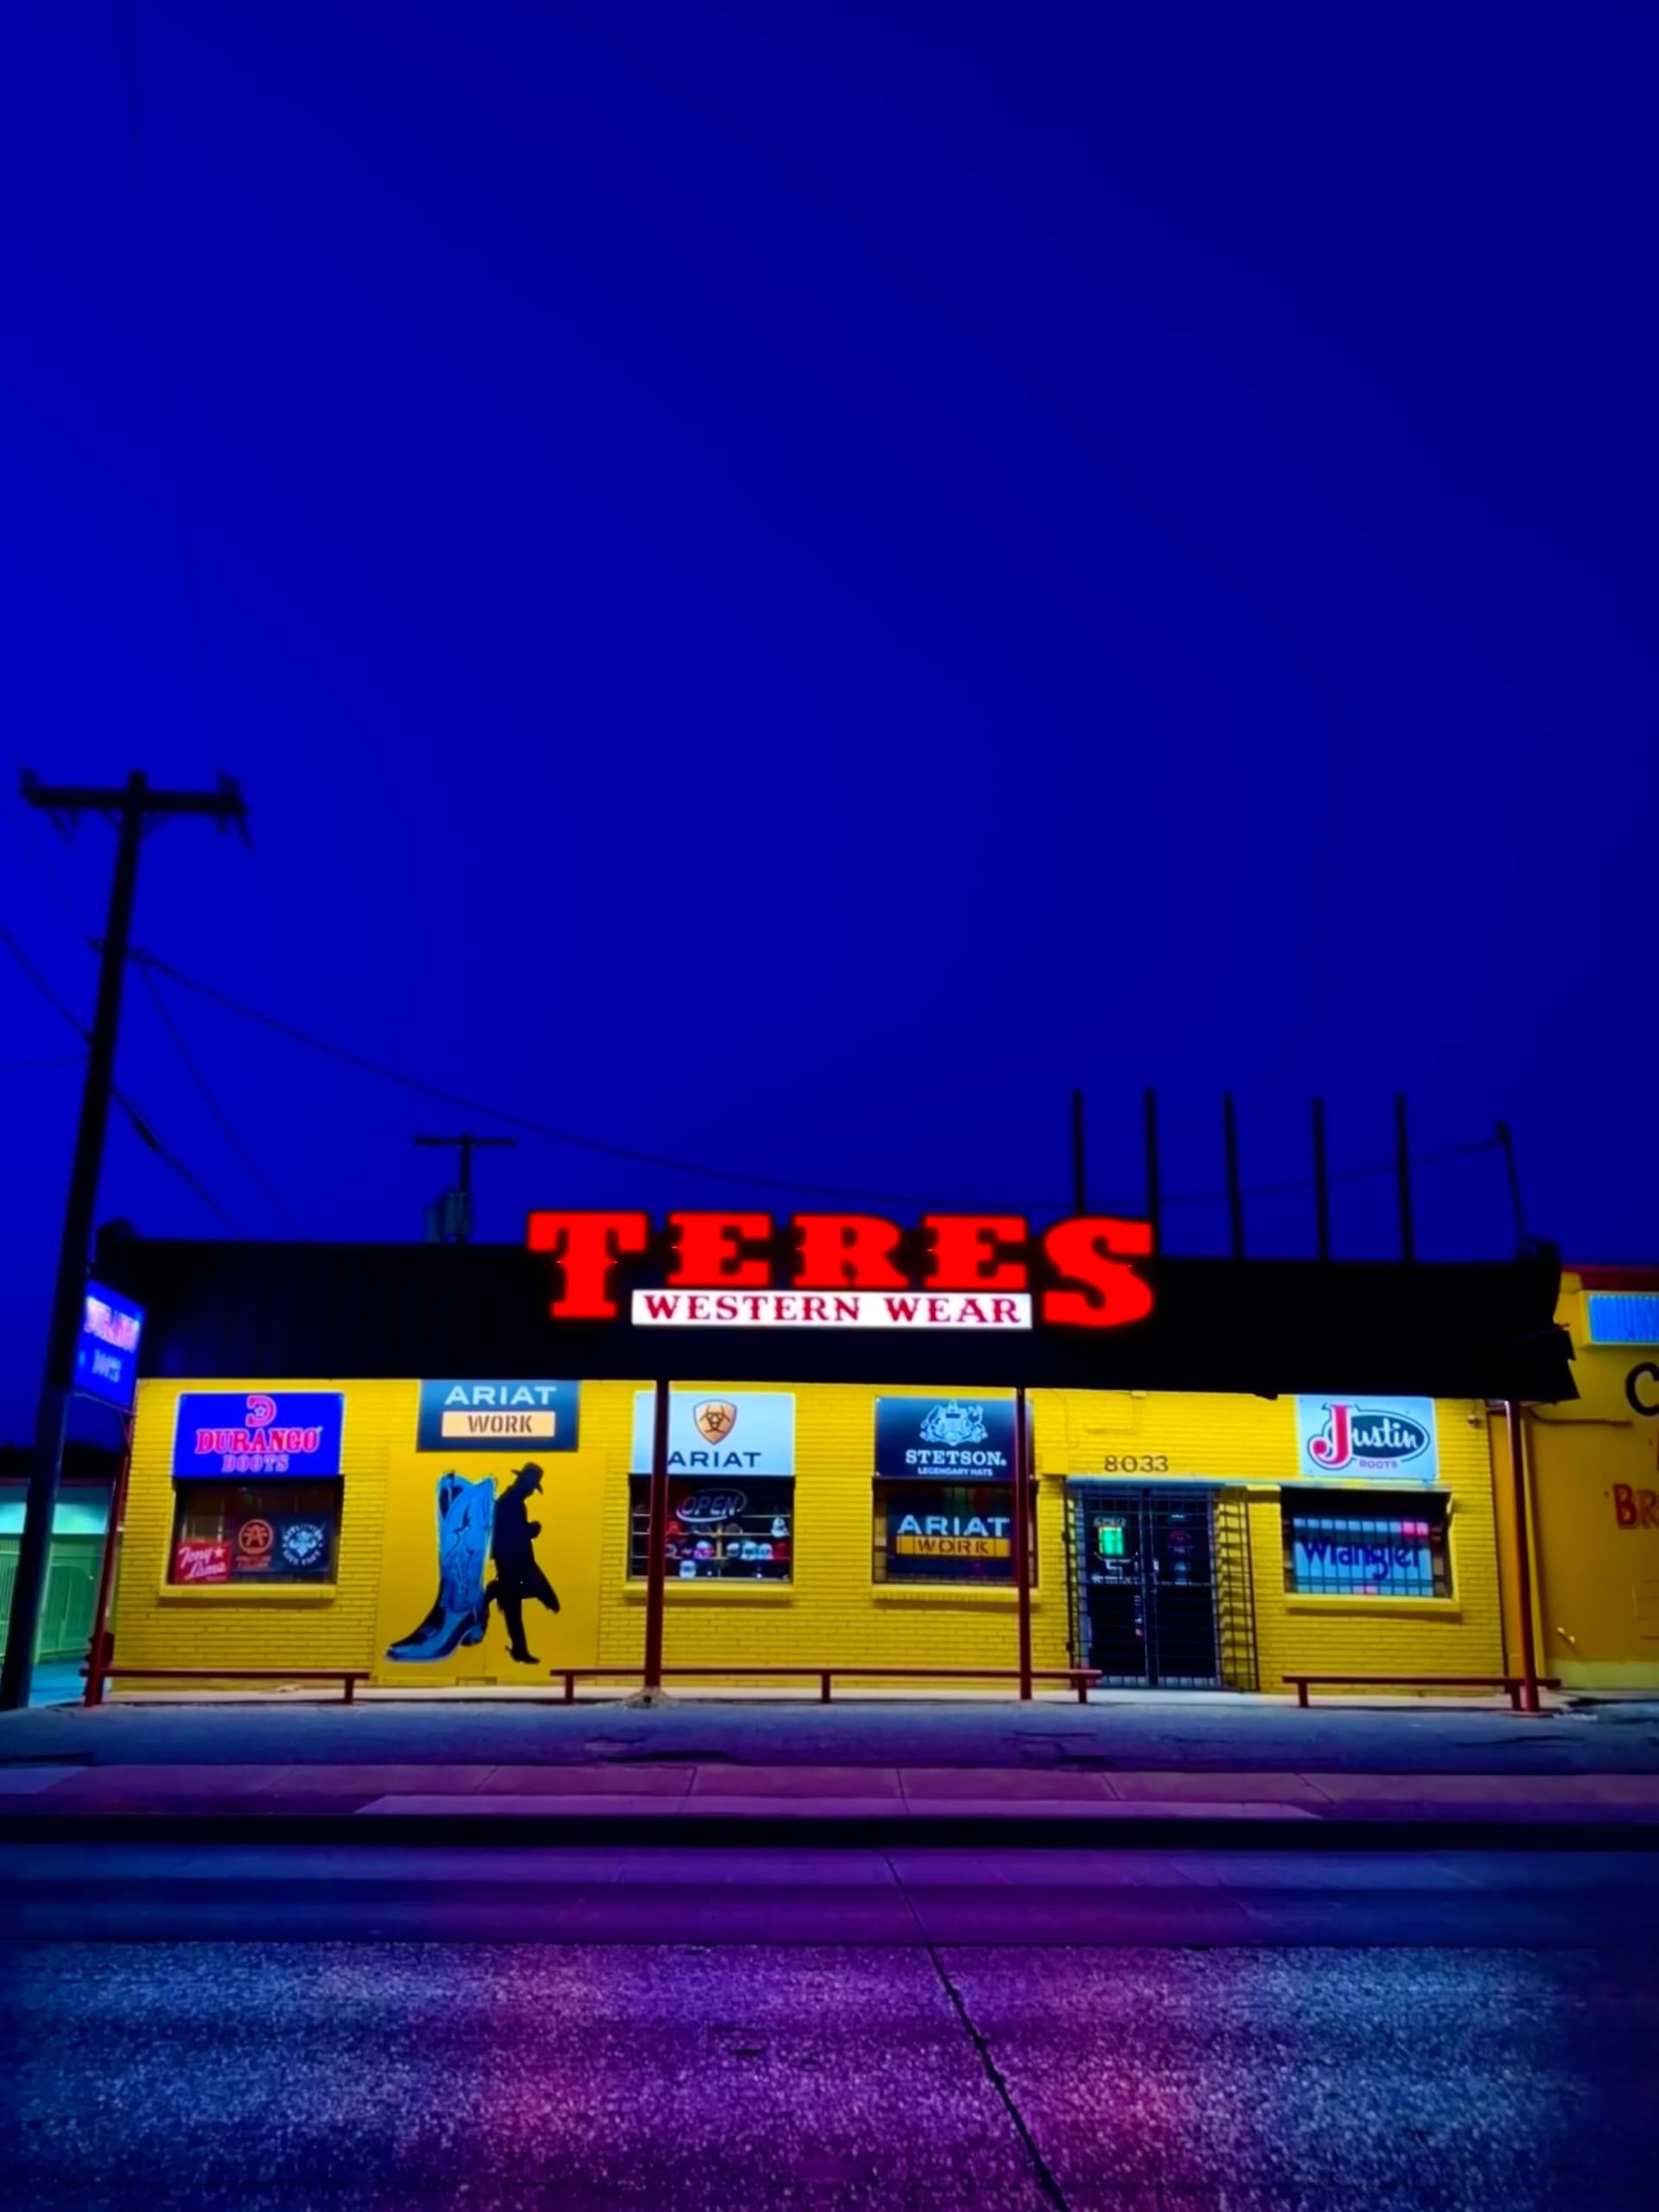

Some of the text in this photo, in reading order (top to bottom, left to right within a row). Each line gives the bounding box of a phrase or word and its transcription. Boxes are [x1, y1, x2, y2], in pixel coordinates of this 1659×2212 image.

[528, 1211, 1154, 1328] TERES
[643, 1294, 1022, 1324] WESTERN WEAR
[443, 1385, 557, 1405] ARIAT
[467, 1414, 532, 1433] WORK
[194, 1428, 321, 1454] DURANGO
[1312, 1403, 1418, 1466] Justin
[221, 1454, 289, 1473] BOOTS
[668, 1451, 762, 1468] ARIAT
[1103, 1454, 1169, 1473] 8033
[1359, 1459, 1398, 1469] BOOTS
[969, 1467, 994, 1477] HATS
[681, 1495, 740, 1516] OPEN
[896, 1514, 1010, 1538] ARIAT
[918, 1538, 990, 1554] WORK
[179, 1547, 213, 1569] Tony
[1303, 1540, 1421, 1580] Wrangler
